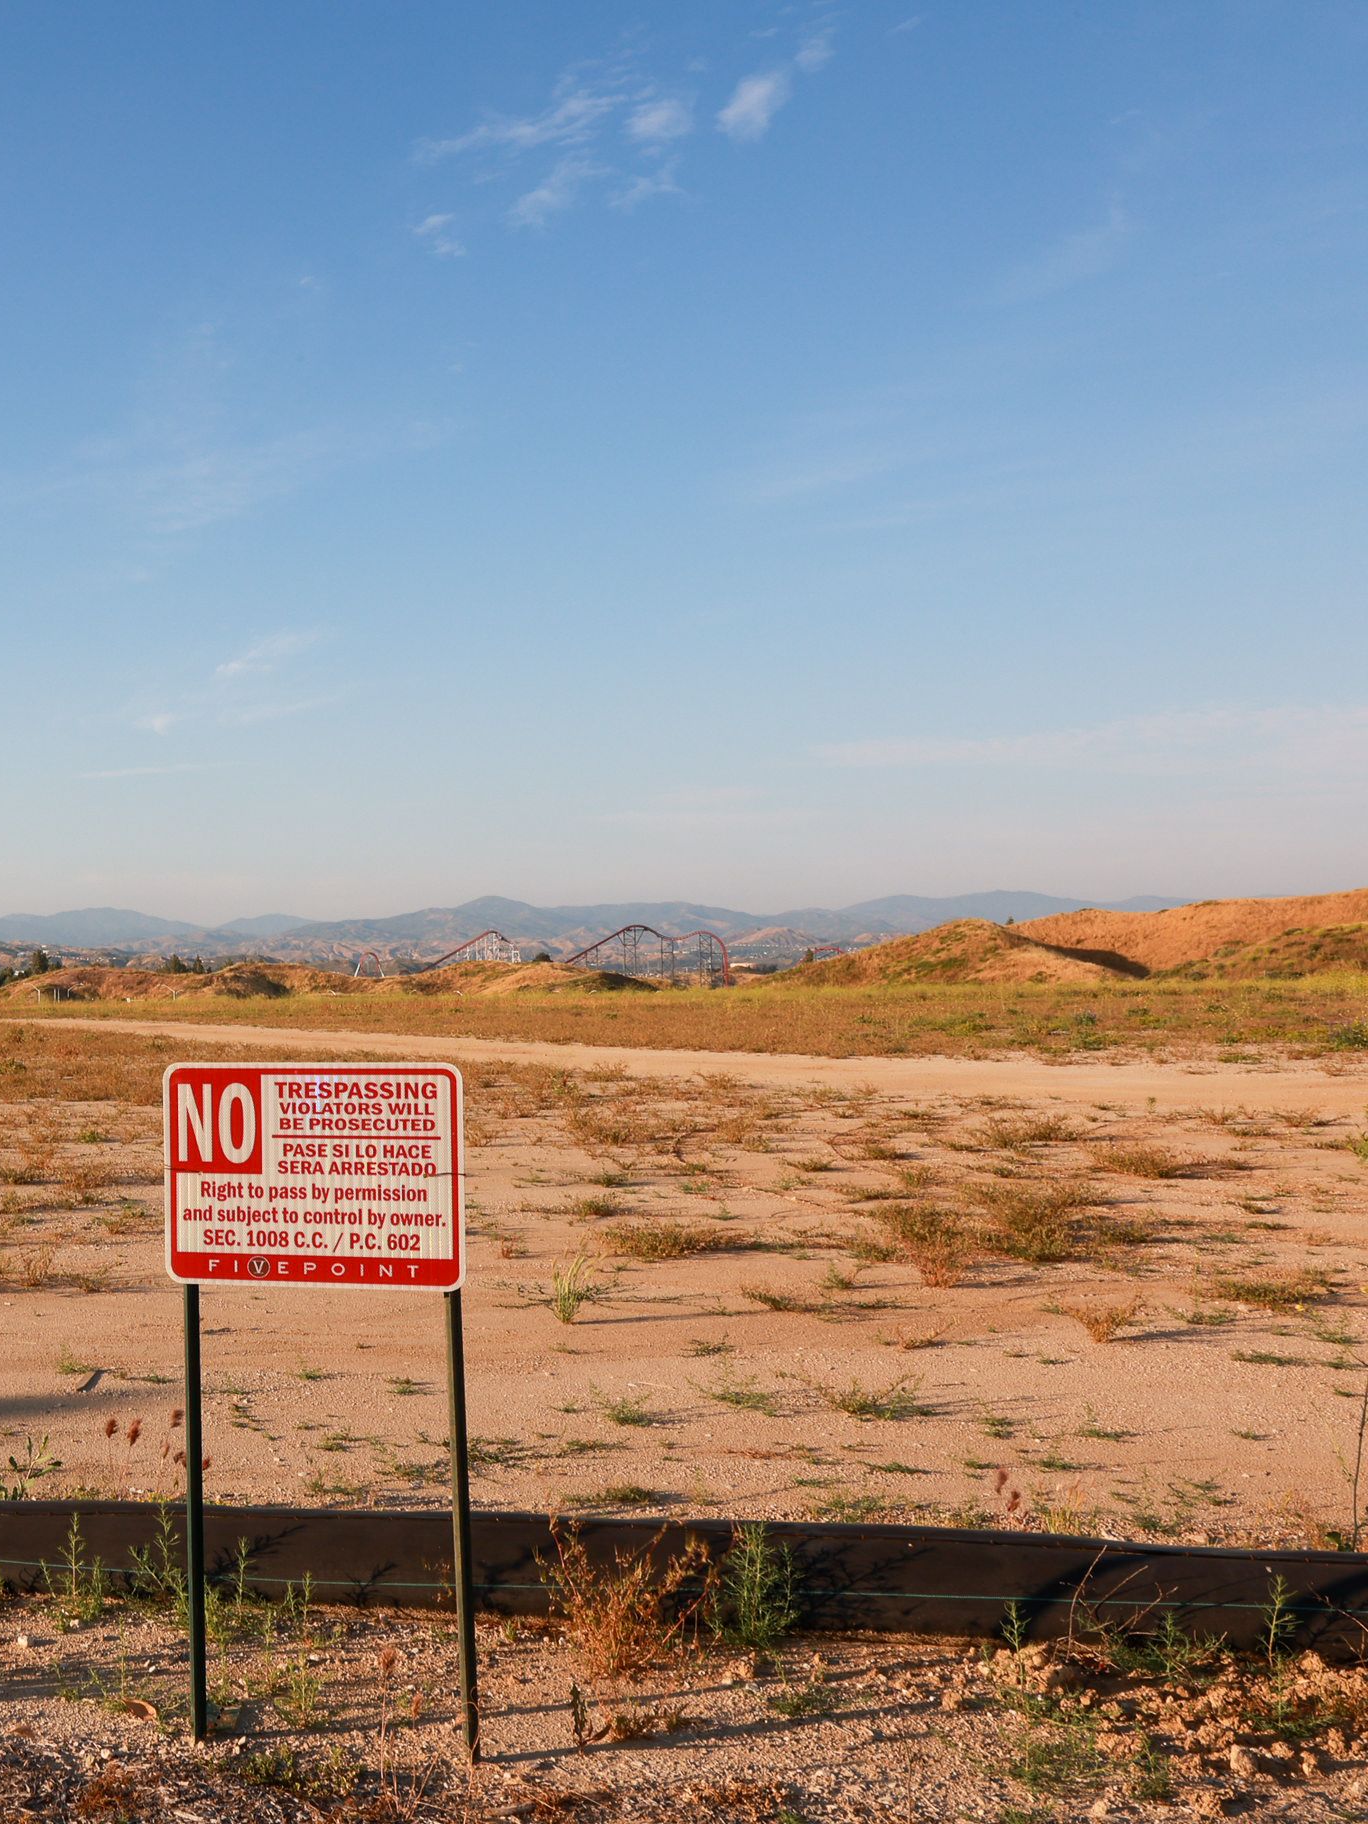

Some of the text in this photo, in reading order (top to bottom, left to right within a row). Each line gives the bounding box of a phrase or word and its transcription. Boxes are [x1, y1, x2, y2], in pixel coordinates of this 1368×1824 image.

[275, 1082, 438, 1099] TRESPASSING
[280, 1103, 435, 1115] VIOLATORS WILL
[178, 1083, 256, 1164] NO
[279, 1118, 436, 1132] BE PROSECUTED
[283, 1144, 432, 1159] PASE SI LO HACE
[278, 1161, 437, 1176] SERA ARRESTADO
[201, 1181, 427, 1206] Right to pass by permission
[183, 1207, 446, 1229] and subject to control by owner.
[204, 1229, 420, 1252] SEC. 1008 C.C. / P.C. 602
